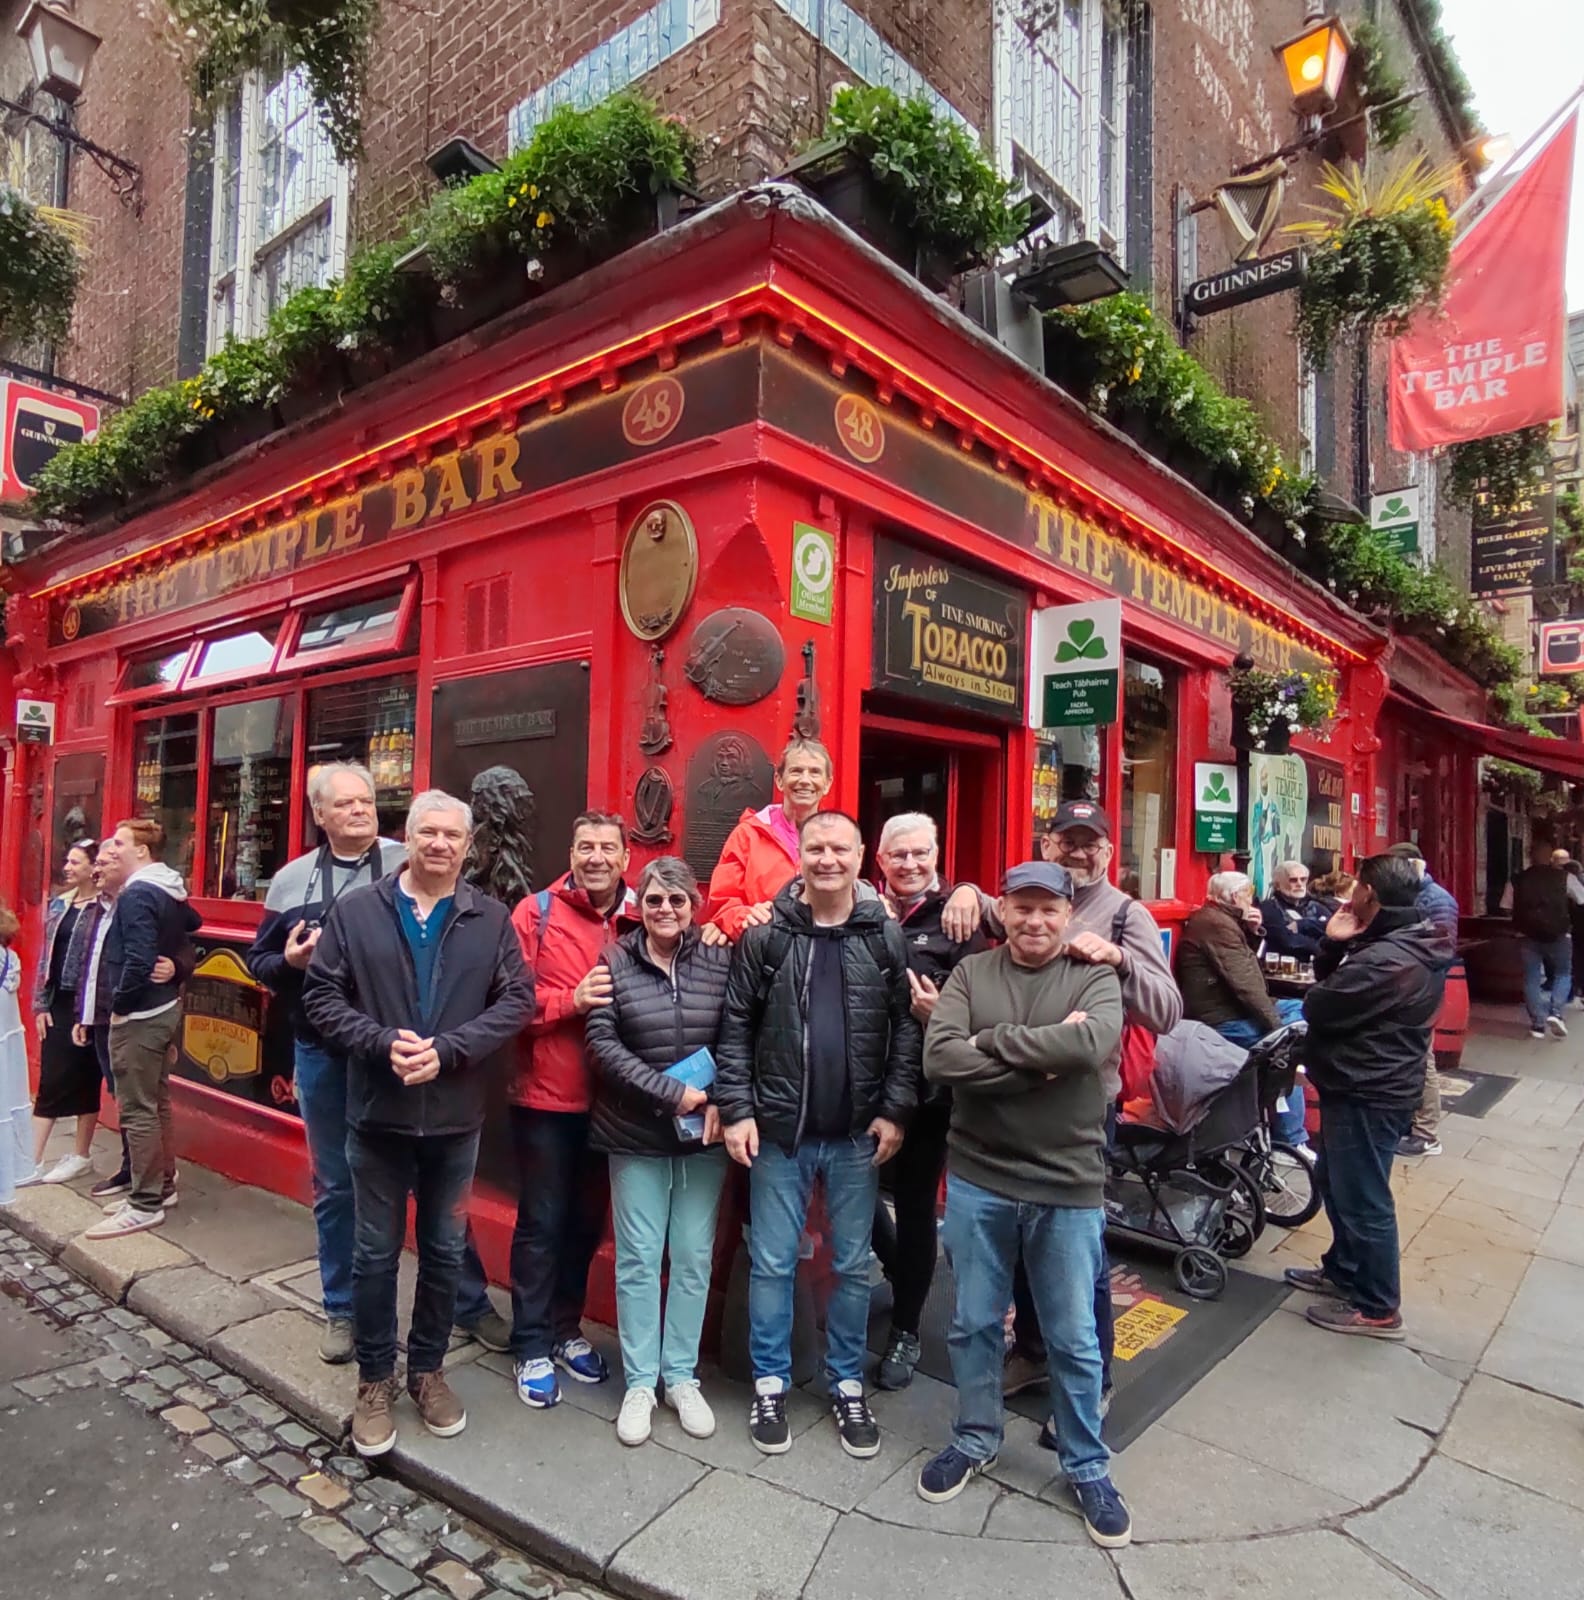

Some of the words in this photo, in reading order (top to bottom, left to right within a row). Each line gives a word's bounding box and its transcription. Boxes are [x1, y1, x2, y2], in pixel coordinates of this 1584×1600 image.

[1193, 254, 1293, 301] GUINNESS
[1443, 337, 1503, 364] THE
[1400, 341, 1548, 395] TEMPLE
[1434, 378, 1509, 411] BAR
[631, 388, 671, 435] 48
[843, 401, 874, 448] 48
[20, 427, 71, 447] GUINNES
[116, 564, 180, 622] THE
[191, 498, 365, 597] TEMPLE
[391, 434, 523, 531] BAR
[1476, 533, 1503, 545] BEER
[1503, 526, 1549, 540] GARDEN
[1479, 562, 1505, 574] LIVE
[1506, 558, 1546, 571] MUSIC
[1493, 570, 1528, 582] DAILY
[884, 564, 949, 600] Importers
[925, 588, 937, 602] OF
[1028, 495, 1114, 586] THE
[1125, 547, 1241, 645] TEMPLE
[1252, 620, 1292, 669] BAR
[799, 598, 826, 616] Member
[801, 590, 825, 606] Official
[941, 602, 964, 625] FINE
[965, 609, 1007, 639] SMOKING
[901, 600, 1007, 680] TOBACCO
[924, 665, 965, 688] Always
[970, 678, 981, 691] in
[984, 679, 1014, 701] Stock
[1051, 680, 1073, 691] Teach
[1072, 689, 1088, 699] Pub
[1282, 759, 1297, 780] THE
[1275, 776, 1303, 800] TEMPLE
[1281, 797, 1297, 818] BAR
[1115, 1306, 1154, 1336] UBLIN
